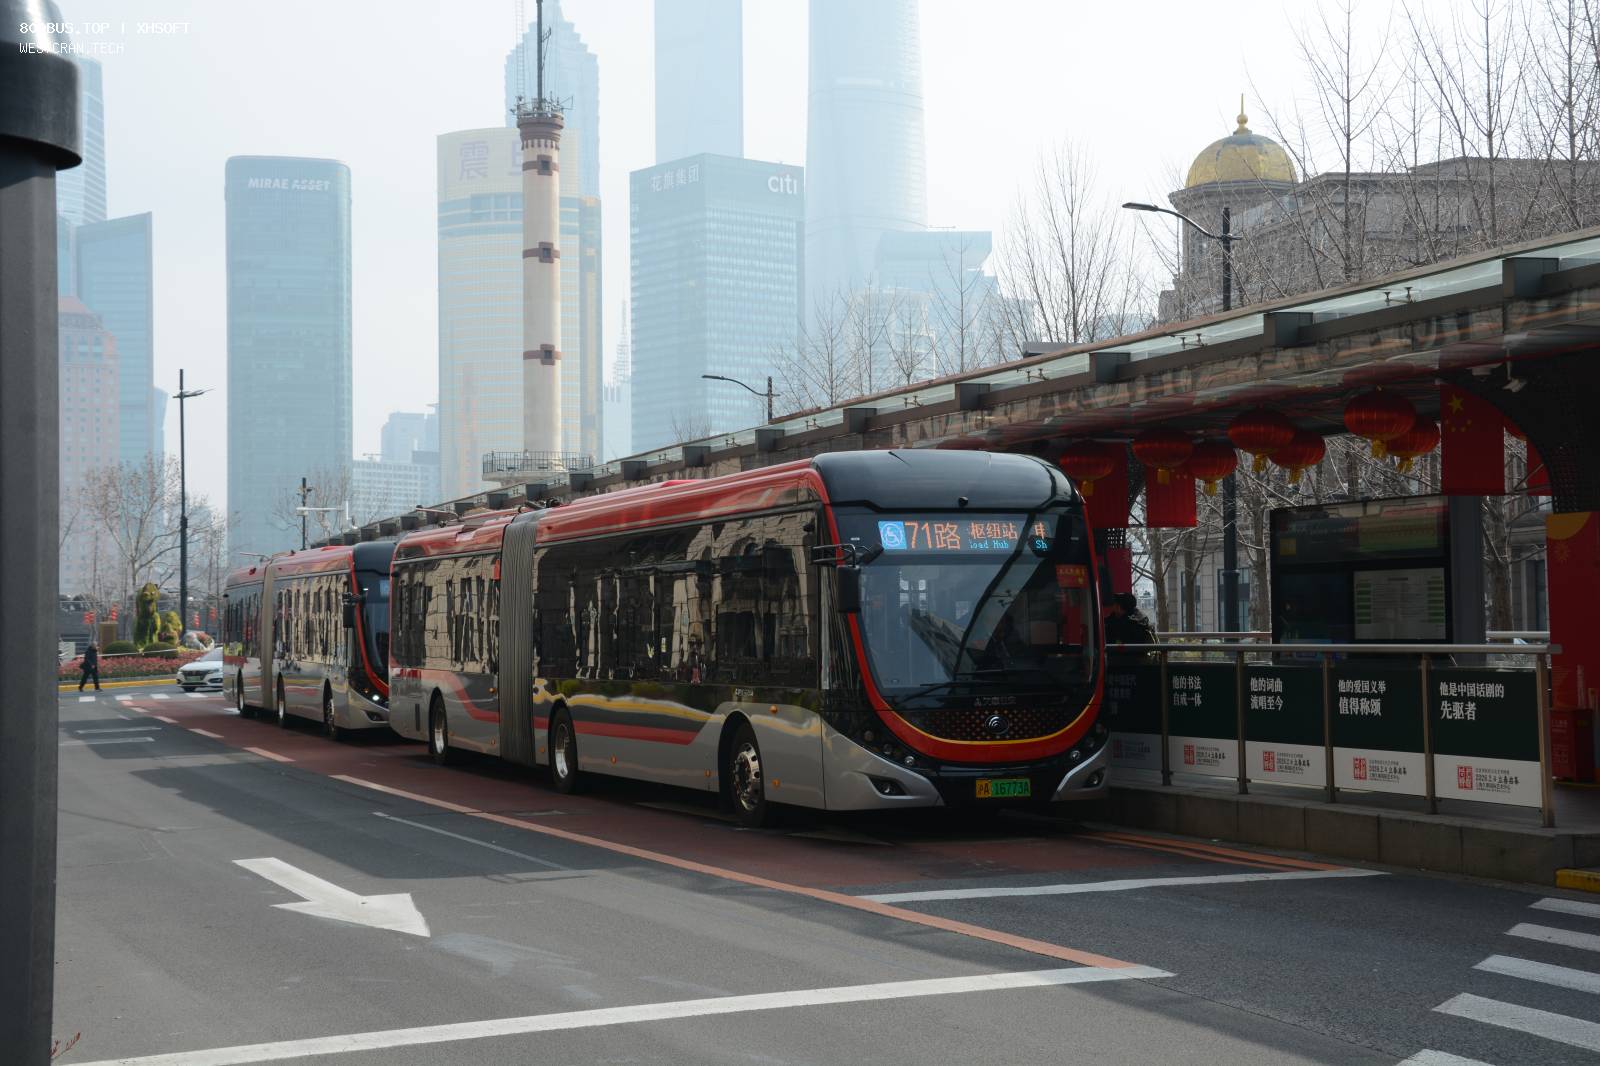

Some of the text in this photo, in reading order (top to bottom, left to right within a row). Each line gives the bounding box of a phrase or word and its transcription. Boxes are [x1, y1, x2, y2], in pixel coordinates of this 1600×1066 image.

[248, 177, 330, 191] MIRAE ASSET
[649, 163, 700, 192] 花旗集团
[767, 173, 798, 194] citi
[905, 521, 961, 550] 71路
[970, 522, 1018, 539] 枢纽站
[993, 540, 1009, 549] Hub
[1172, 675, 1202, 690] 他的书法
[1250, 677, 1283, 693] 他的词曲
[1338, 679, 1386, 694] 他的爱国义举
[1440, 681, 1505, 699] 他是中国话剧的
[1173, 691, 1202, 707] 自成一体
[1250, 694, 1284, 711] 流唱至今
[1339, 696, 1382, 716] 值得称颂
[1440, 700, 1477, 720] 先驱者
